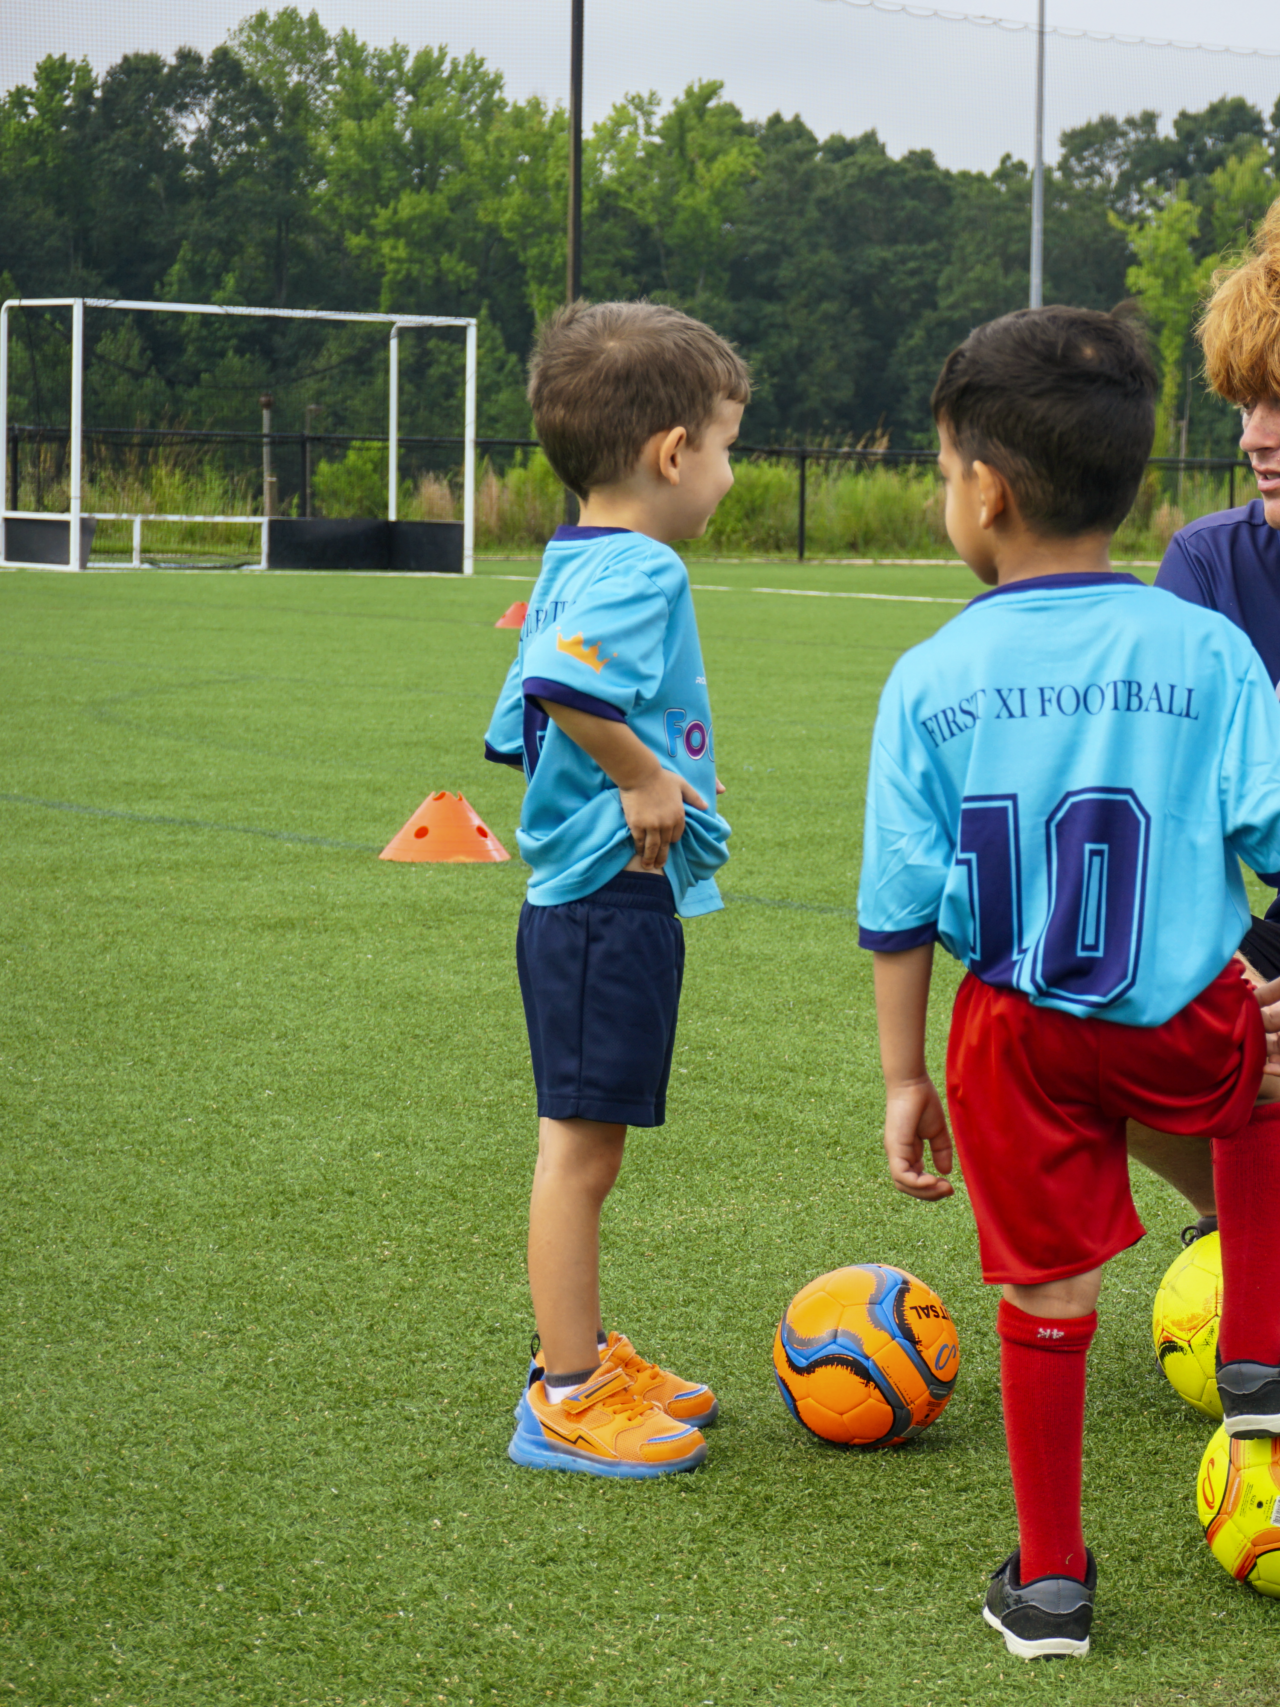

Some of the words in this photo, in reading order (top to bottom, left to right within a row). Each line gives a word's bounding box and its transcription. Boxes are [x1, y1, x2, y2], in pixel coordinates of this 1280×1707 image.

[920, 689, 987, 749] FIRST
[994, 687, 1027, 720] XI
[1039, 680, 1200, 721] FOOTBALL
[955, 787, 1151, 1008] 10
